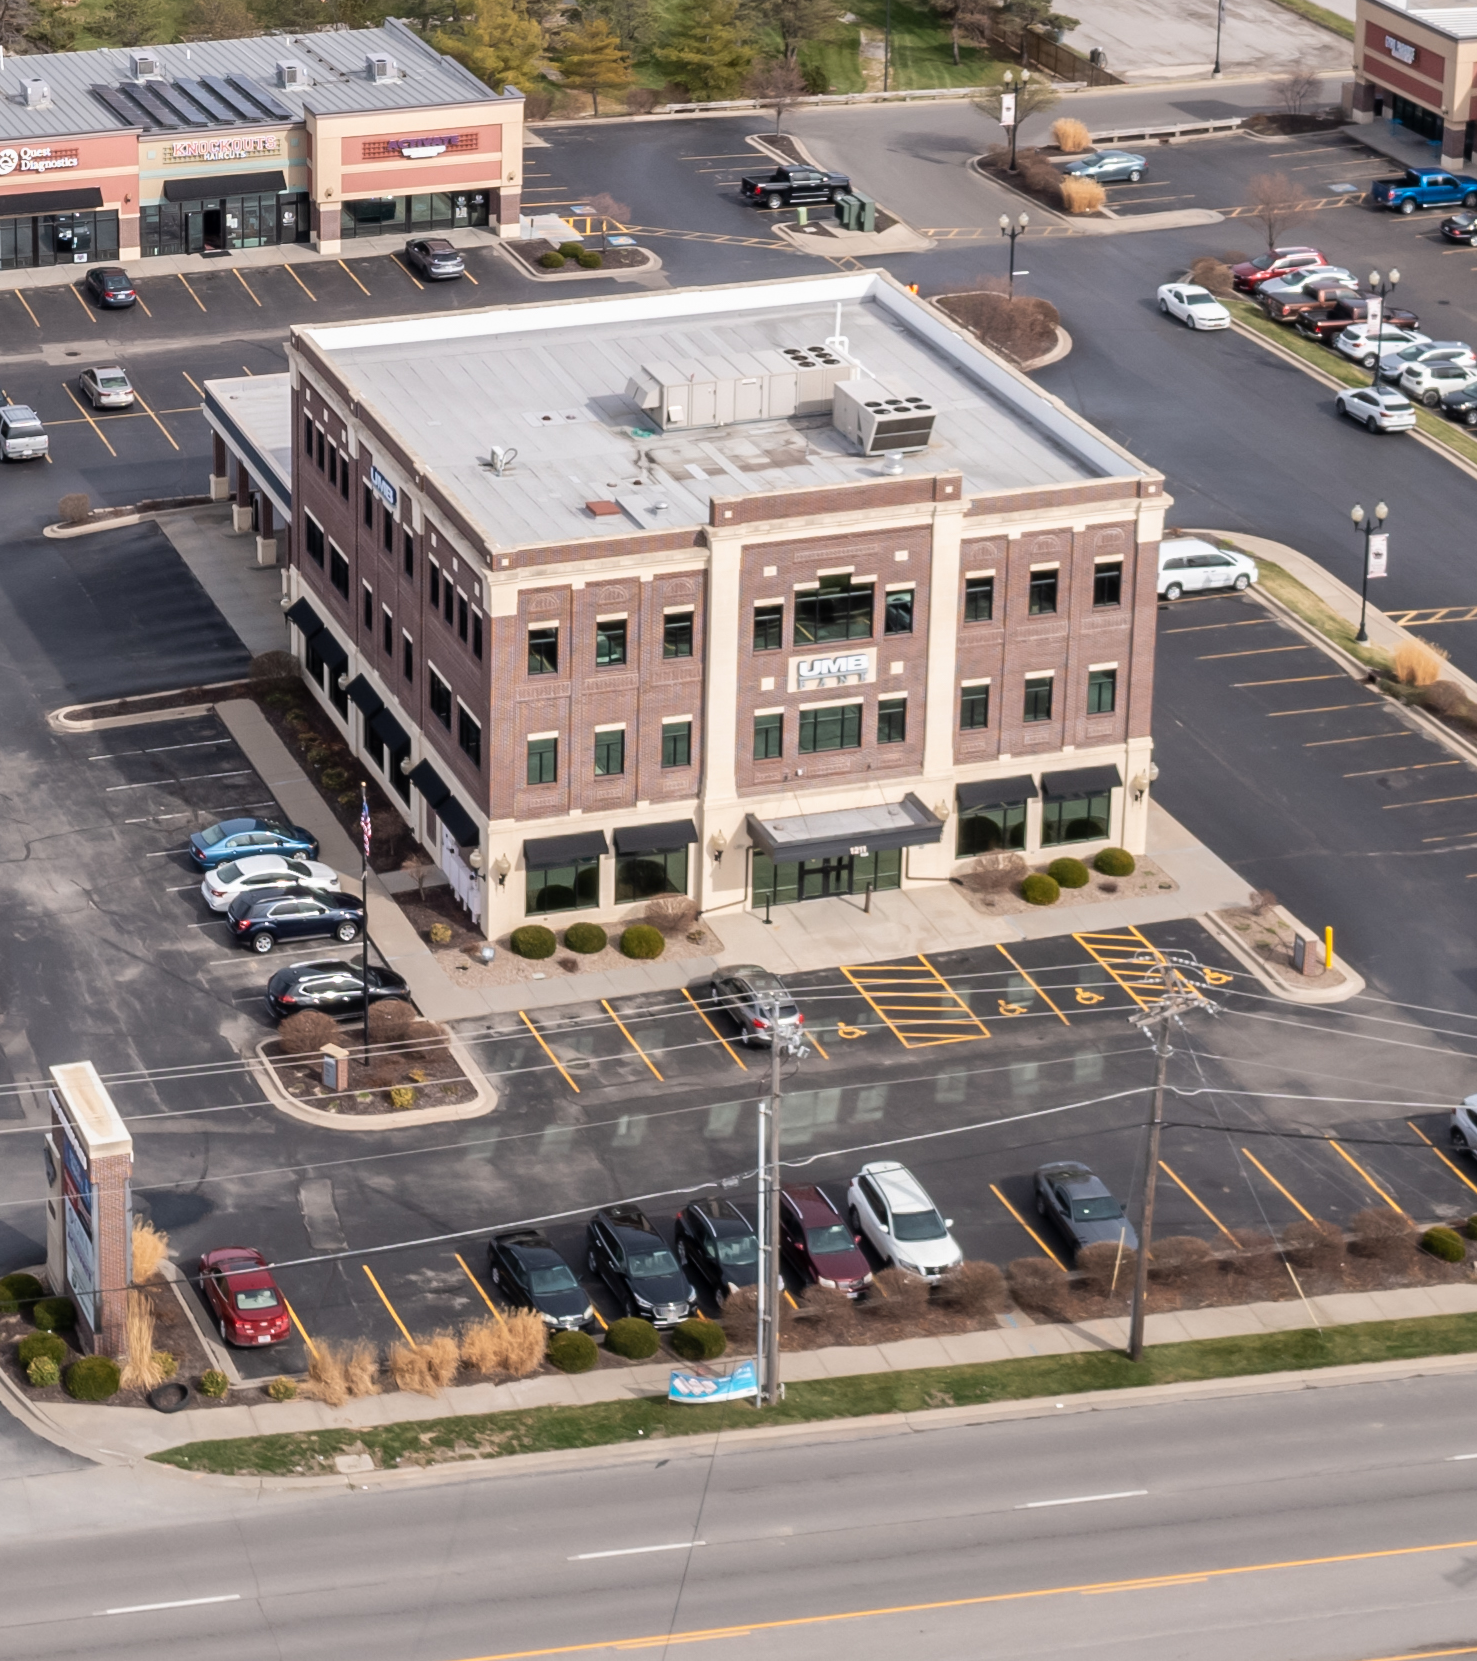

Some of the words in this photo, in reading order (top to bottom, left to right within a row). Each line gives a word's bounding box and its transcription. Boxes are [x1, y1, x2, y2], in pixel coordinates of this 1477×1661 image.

[20, 147, 51, 161] Quest
[172, 135, 276, 157] KNOCKOUTS
[204, 150, 247, 161] HAIRCUTS
[20, 157, 78, 173] Diagnostics
[370, 465, 395, 505] UMB
[798, 654, 869, 677] UMB
